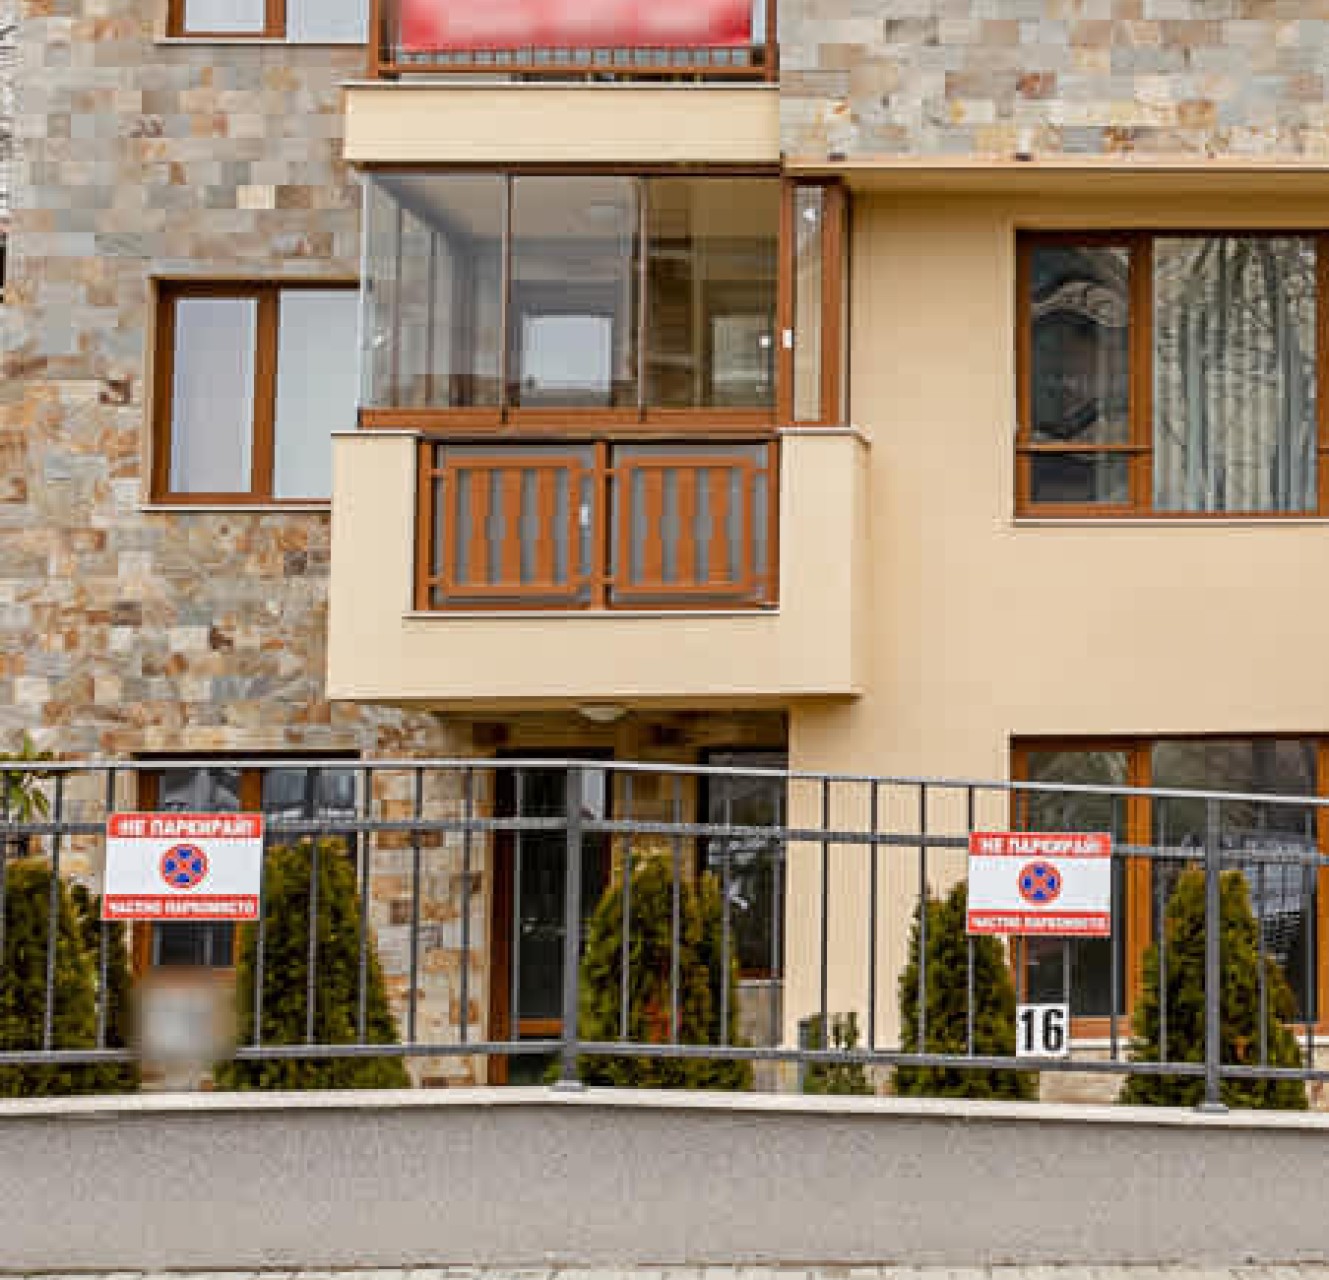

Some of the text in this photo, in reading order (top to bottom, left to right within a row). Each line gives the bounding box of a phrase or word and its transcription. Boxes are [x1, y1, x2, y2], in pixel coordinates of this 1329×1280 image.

[118, 819, 145, 837] НЕ
[981, 837, 1003, 855] НЕ
[1021, 1008, 1064, 1051] 16
